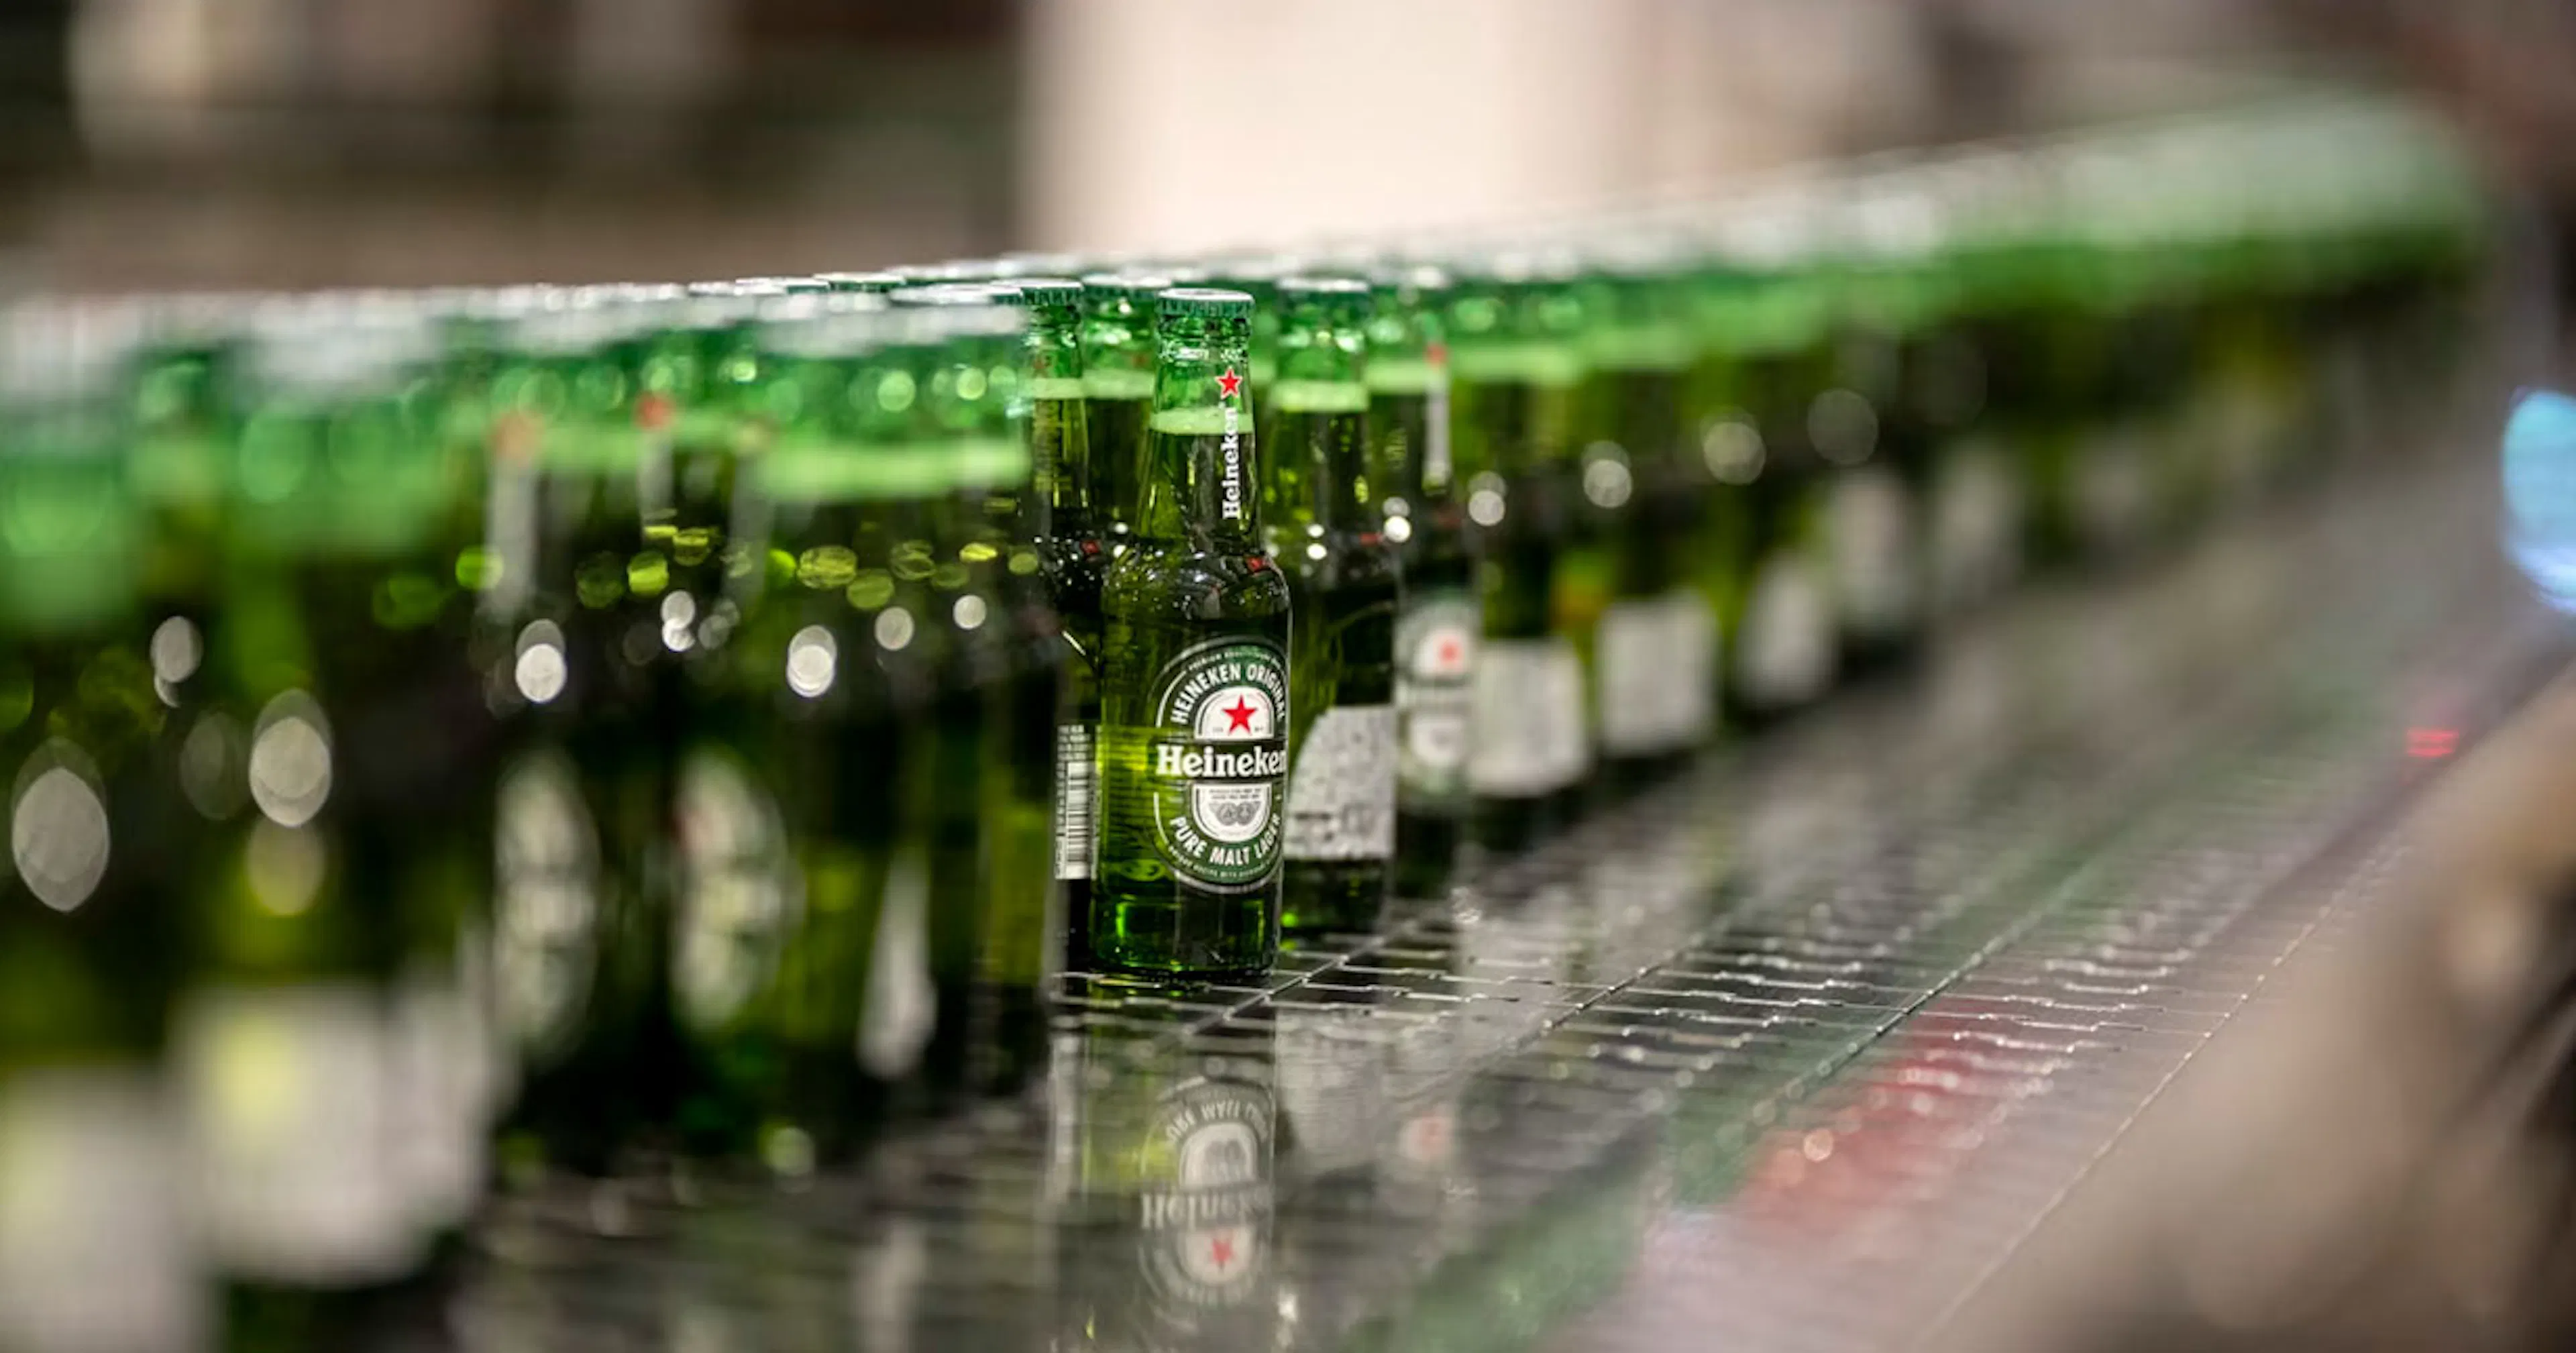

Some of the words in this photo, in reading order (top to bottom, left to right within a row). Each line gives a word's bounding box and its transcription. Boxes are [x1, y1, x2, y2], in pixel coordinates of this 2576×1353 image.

[1220, 407, 1241, 520] Heineken
[1170, 663, 1241, 724] HEINEKEN
[1246, 663, 1285, 723] ORIGINAL
[1169, 816, 1208, 858] PURE
[1210, 846, 1250, 866] MALT
[1253, 812, 1281, 859] LAGER
